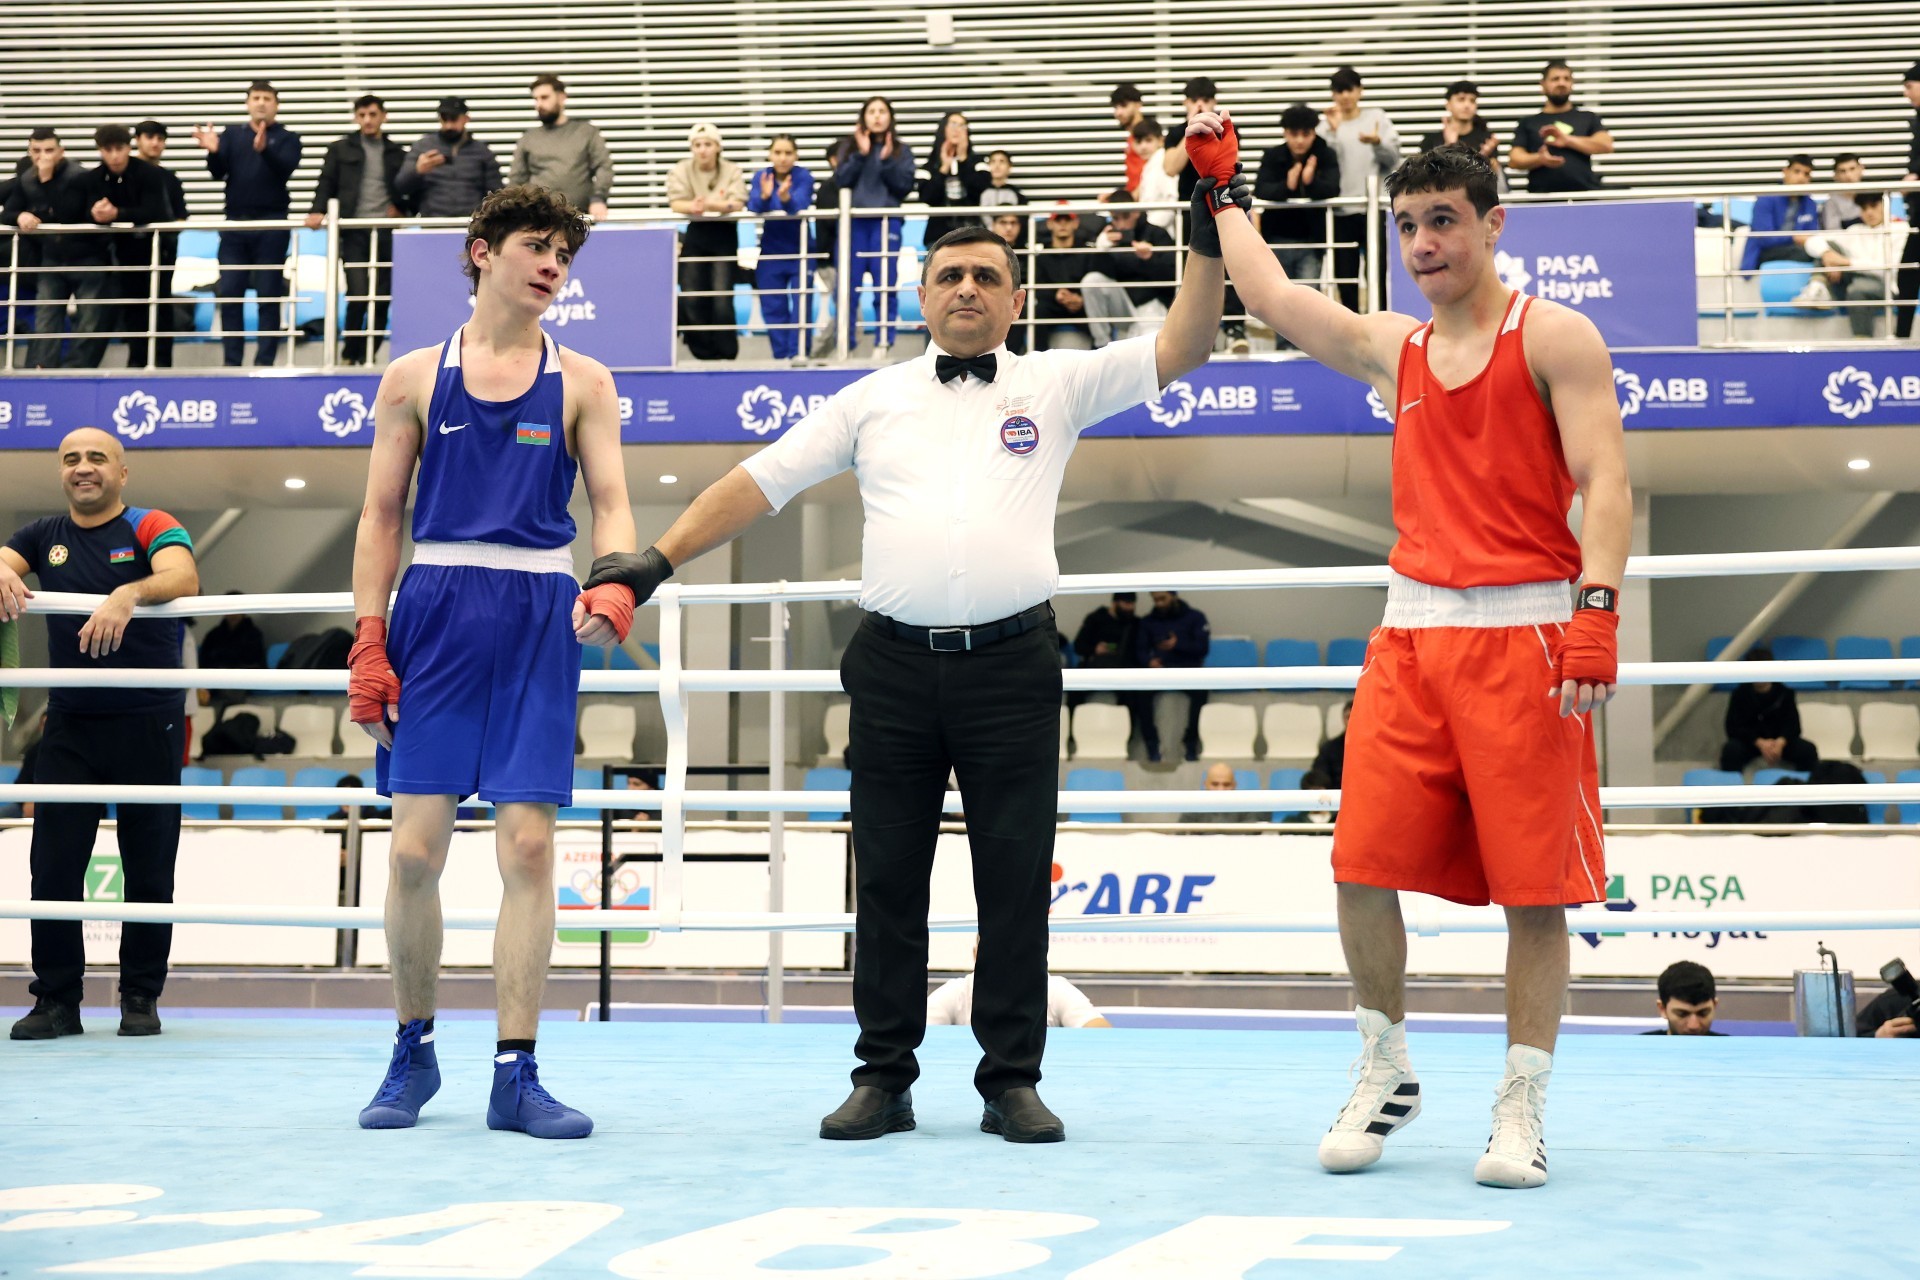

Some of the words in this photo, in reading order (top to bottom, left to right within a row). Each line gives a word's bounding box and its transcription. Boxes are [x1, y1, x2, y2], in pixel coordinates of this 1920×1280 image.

[1536, 255, 1600, 280] PAŞA
[1536, 277, 1613, 305] Həyat
[539, 300, 596, 327] əyat
[1197, 385, 1258, 410] ABB
[1645, 377, 1709, 402] ABB
[1879, 375, 1920, 400] AB
[160, 399, 218, 423] ABB
[786, 394, 837, 418] AB
[1081, 872, 1216, 914] ABF
[1650, 874, 1746, 909] PAŞA
[35, 1200, 1513, 1280] ABF
